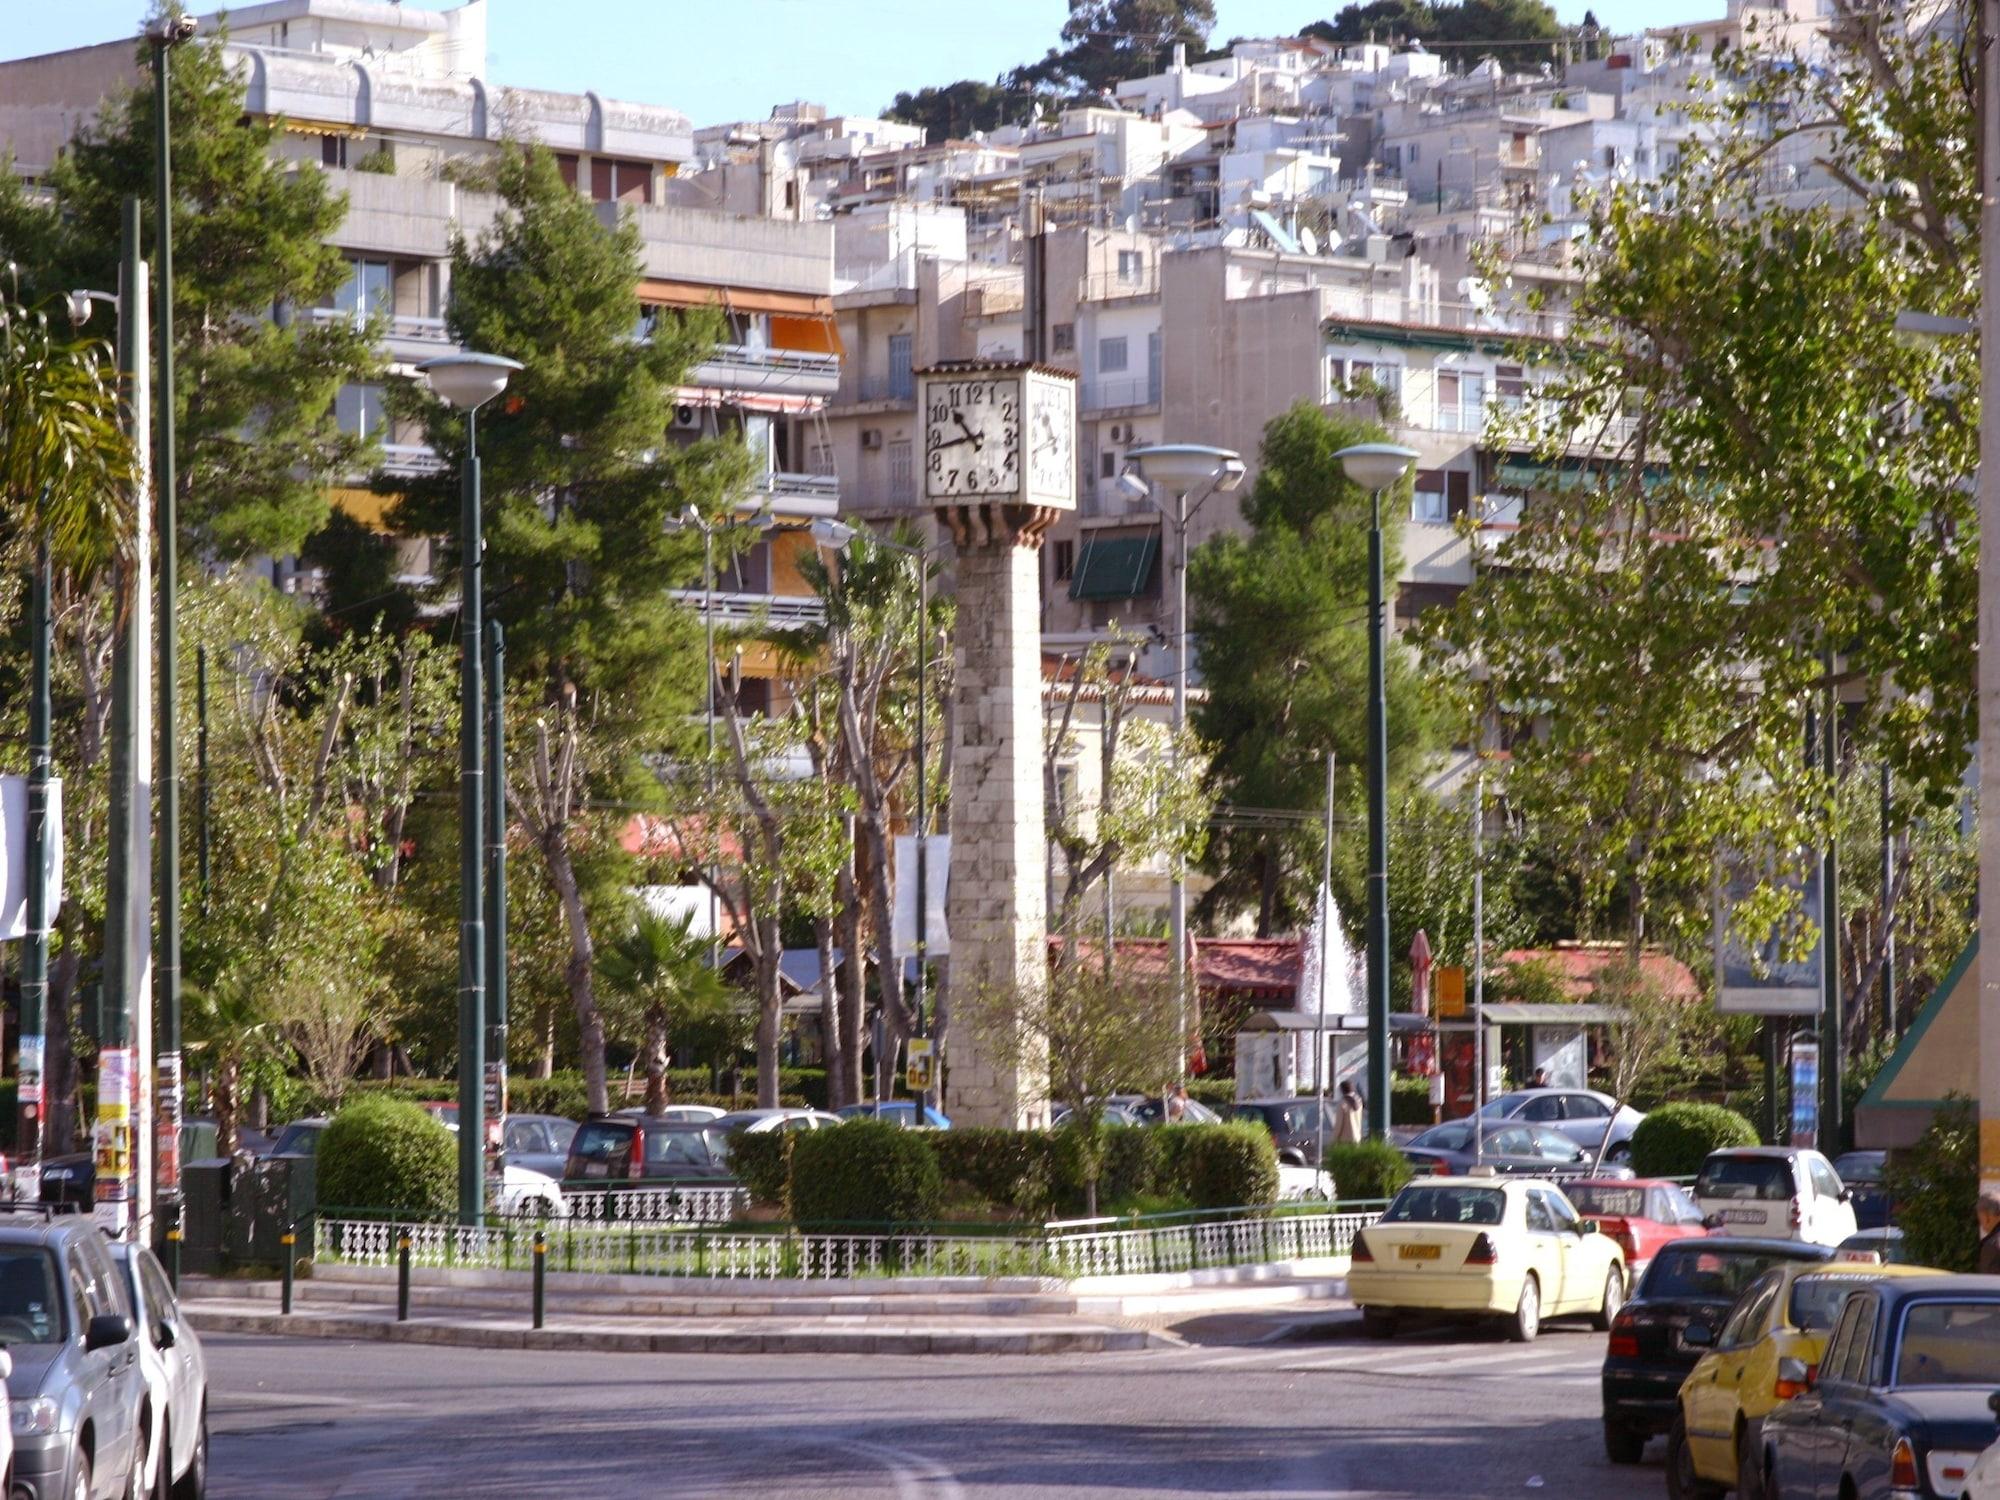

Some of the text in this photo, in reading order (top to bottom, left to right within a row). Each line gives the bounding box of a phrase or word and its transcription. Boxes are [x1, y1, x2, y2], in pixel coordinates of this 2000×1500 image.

[950, 387, 960, 407] 11
[965, 386, 982, 404] 12
[989, 386, 995, 406] 1
[932, 404, 948, 423] 10
[1002, 402, 1012, 422] 2
[932, 429, 941, 448] 9
[1004, 428, 1013, 447] 3
[932, 453, 941, 473] 8
[1003, 452, 1014, 471] 4
[948, 470, 959, 488] 7
[967, 471, 977, 490] 6
[989, 469, 999, 487] 5
